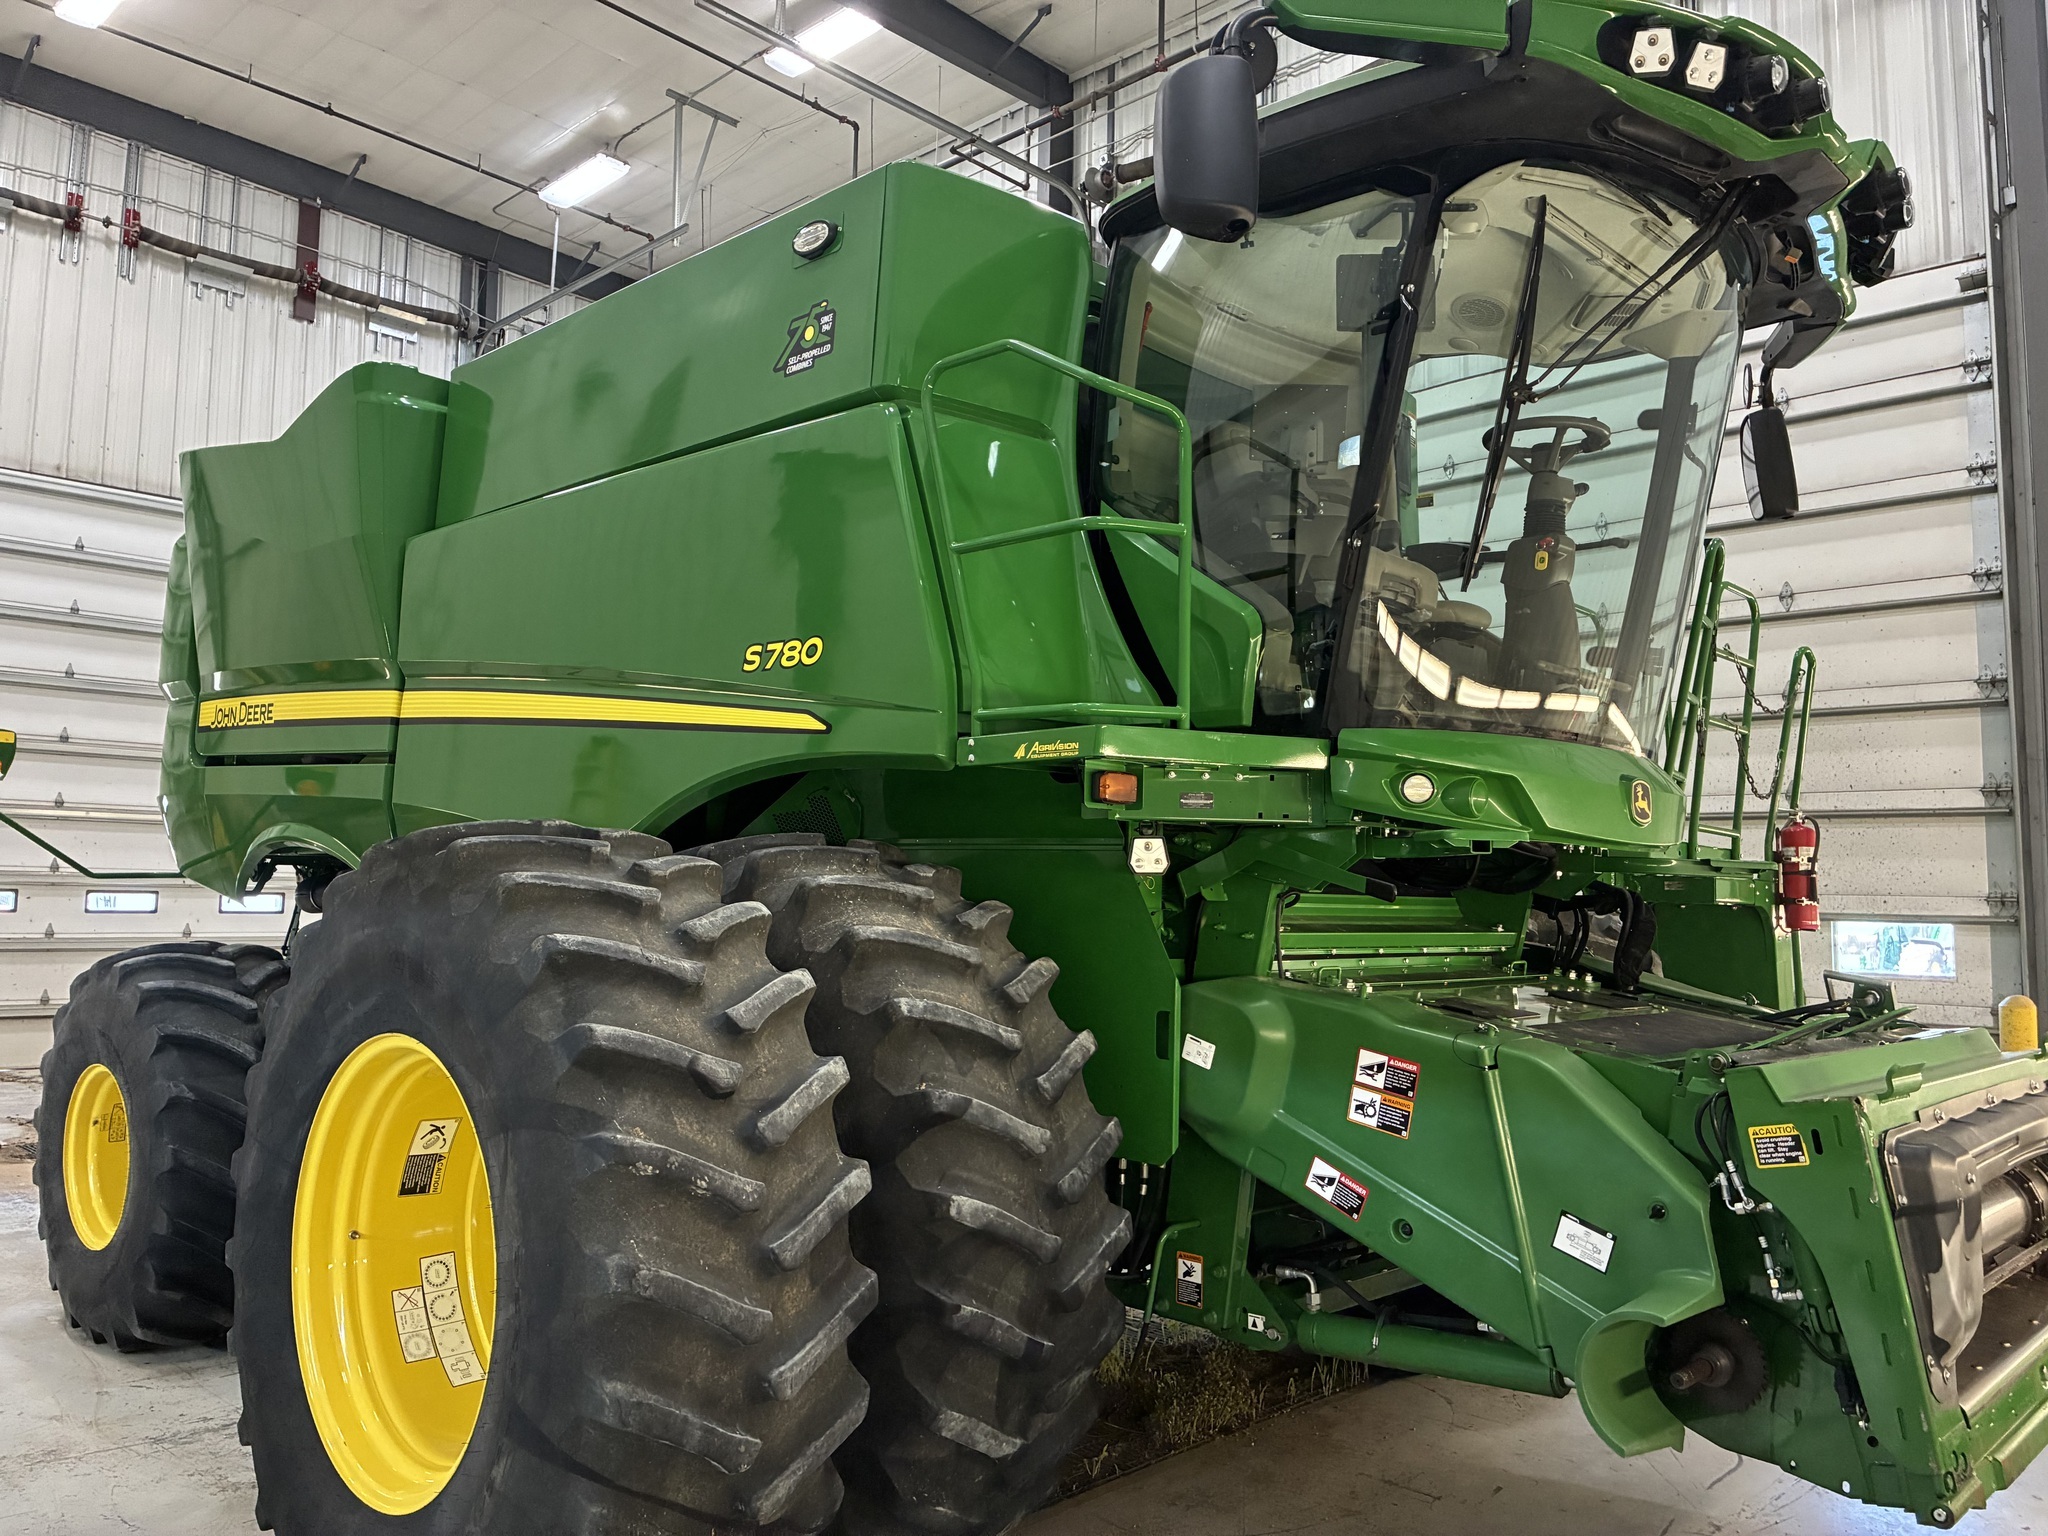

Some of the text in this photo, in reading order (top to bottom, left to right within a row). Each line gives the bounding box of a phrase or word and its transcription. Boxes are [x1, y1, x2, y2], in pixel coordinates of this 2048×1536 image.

[820, 313, 834, 325] SINCE
[821, 322, 833, 332] 1947
[787, 344, 831, 366] SELF-PROPELLED
[785, 358, 813, 374] COMBINES
[742, 635, 824, 673] S780
[210, 702, 274, 726] JOHN DEERE
[1394, 1060, 1417, 1071] DANGER
[1387, 1098, 1411, 1110] WARNING
[1759, 1126, 1799, 1136] CAUTION
[432, 1162, 444, 1193] CAUTION
[1345, 1179, 1367, 1196] DANGER
